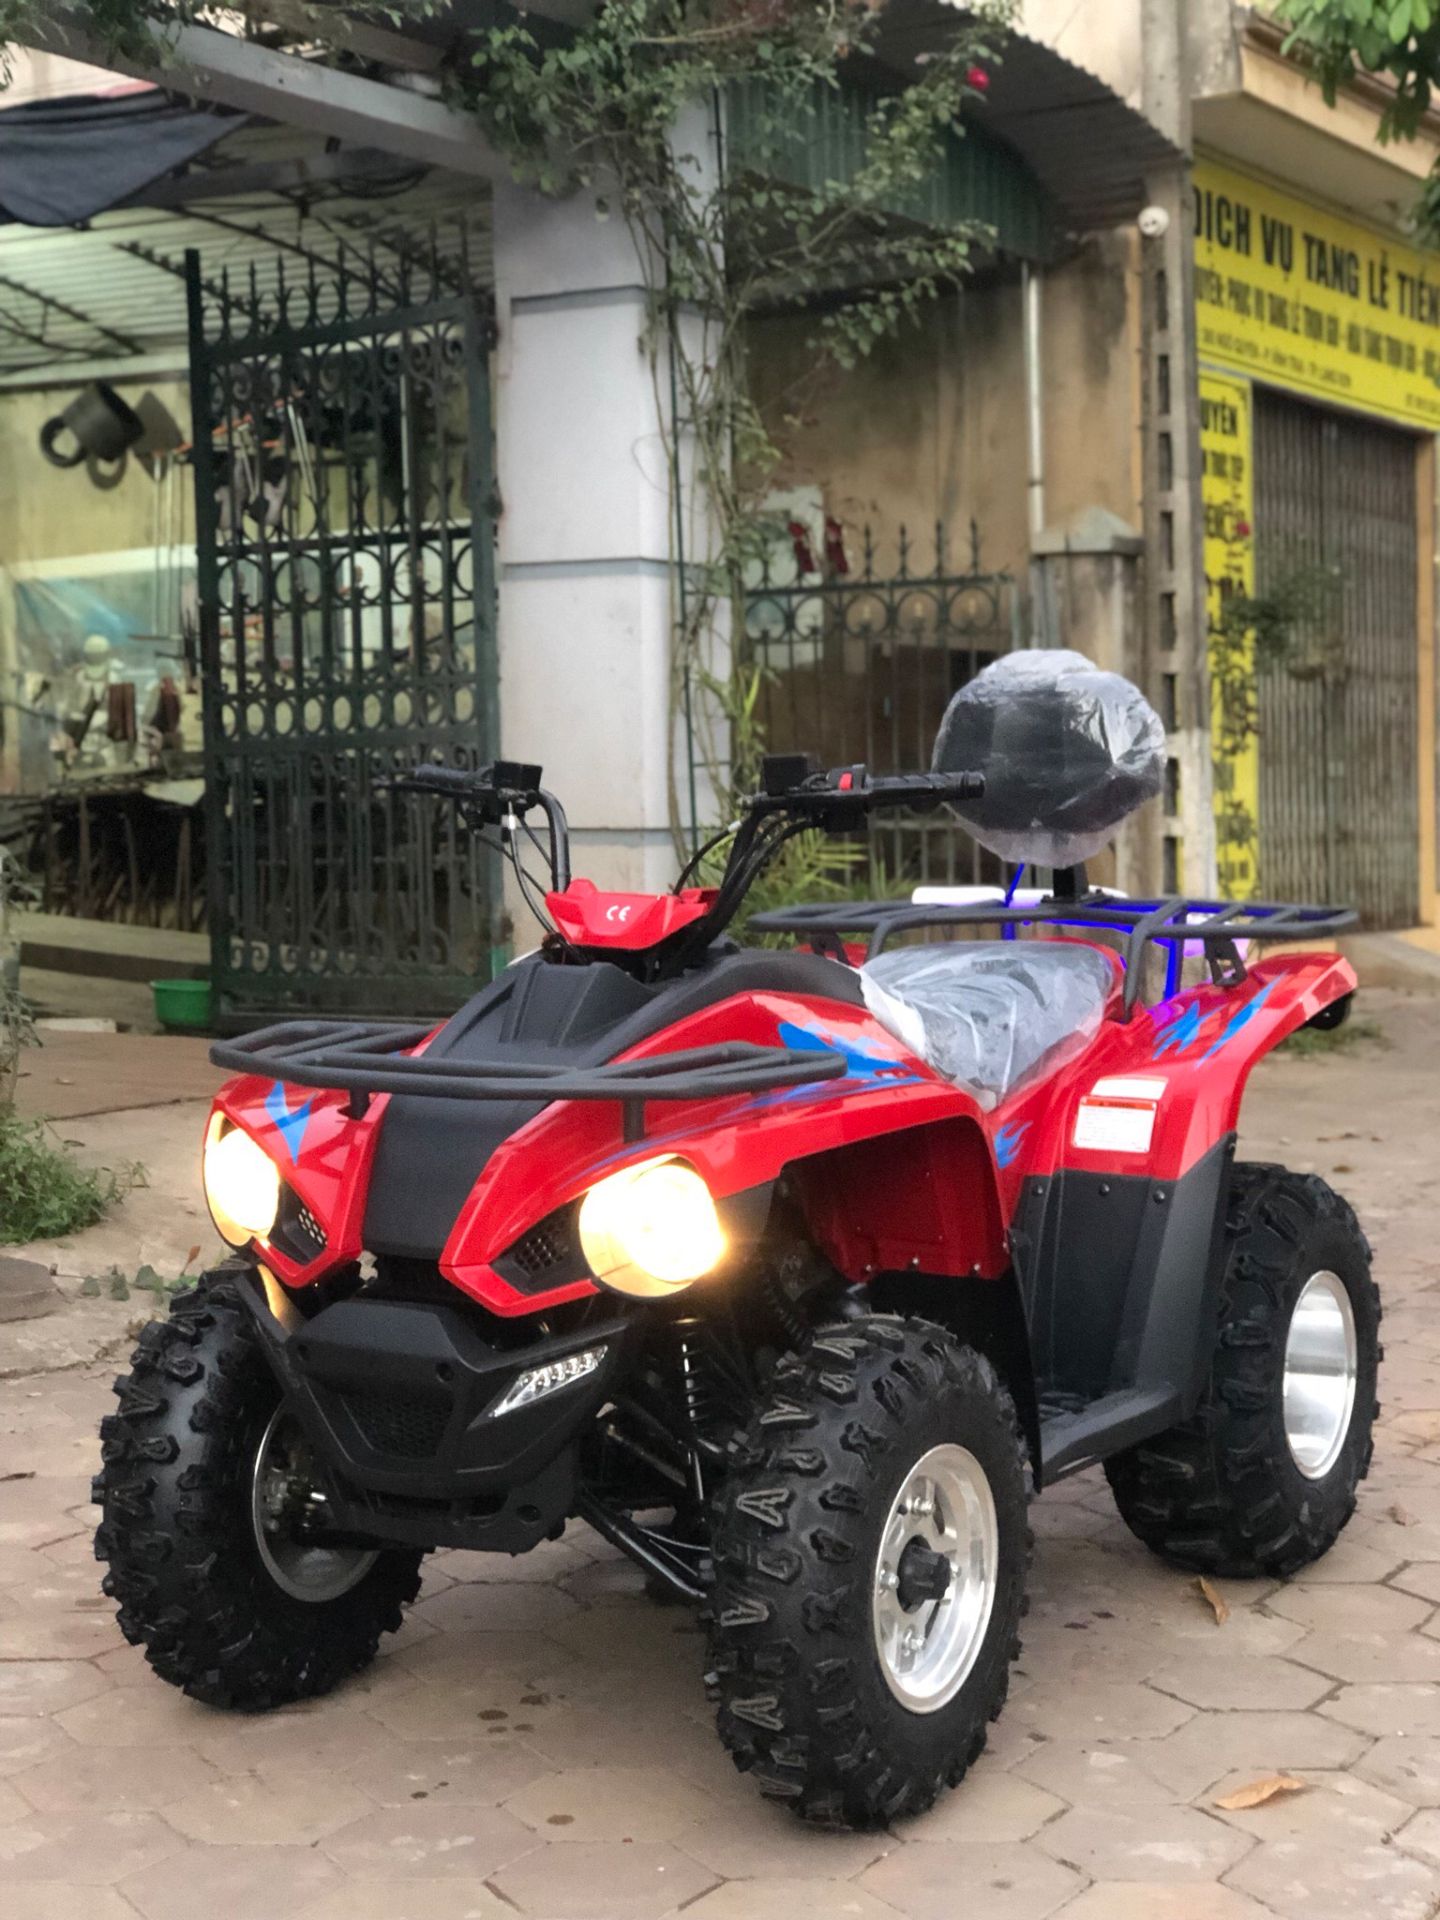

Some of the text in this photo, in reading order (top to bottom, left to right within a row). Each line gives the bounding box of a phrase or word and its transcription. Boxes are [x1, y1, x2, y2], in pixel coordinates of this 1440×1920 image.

[1261, 213, 1293, 282] VỤ
[1303, 232, 1360, 300] TANG
[606, 905, 631, 921] CE
